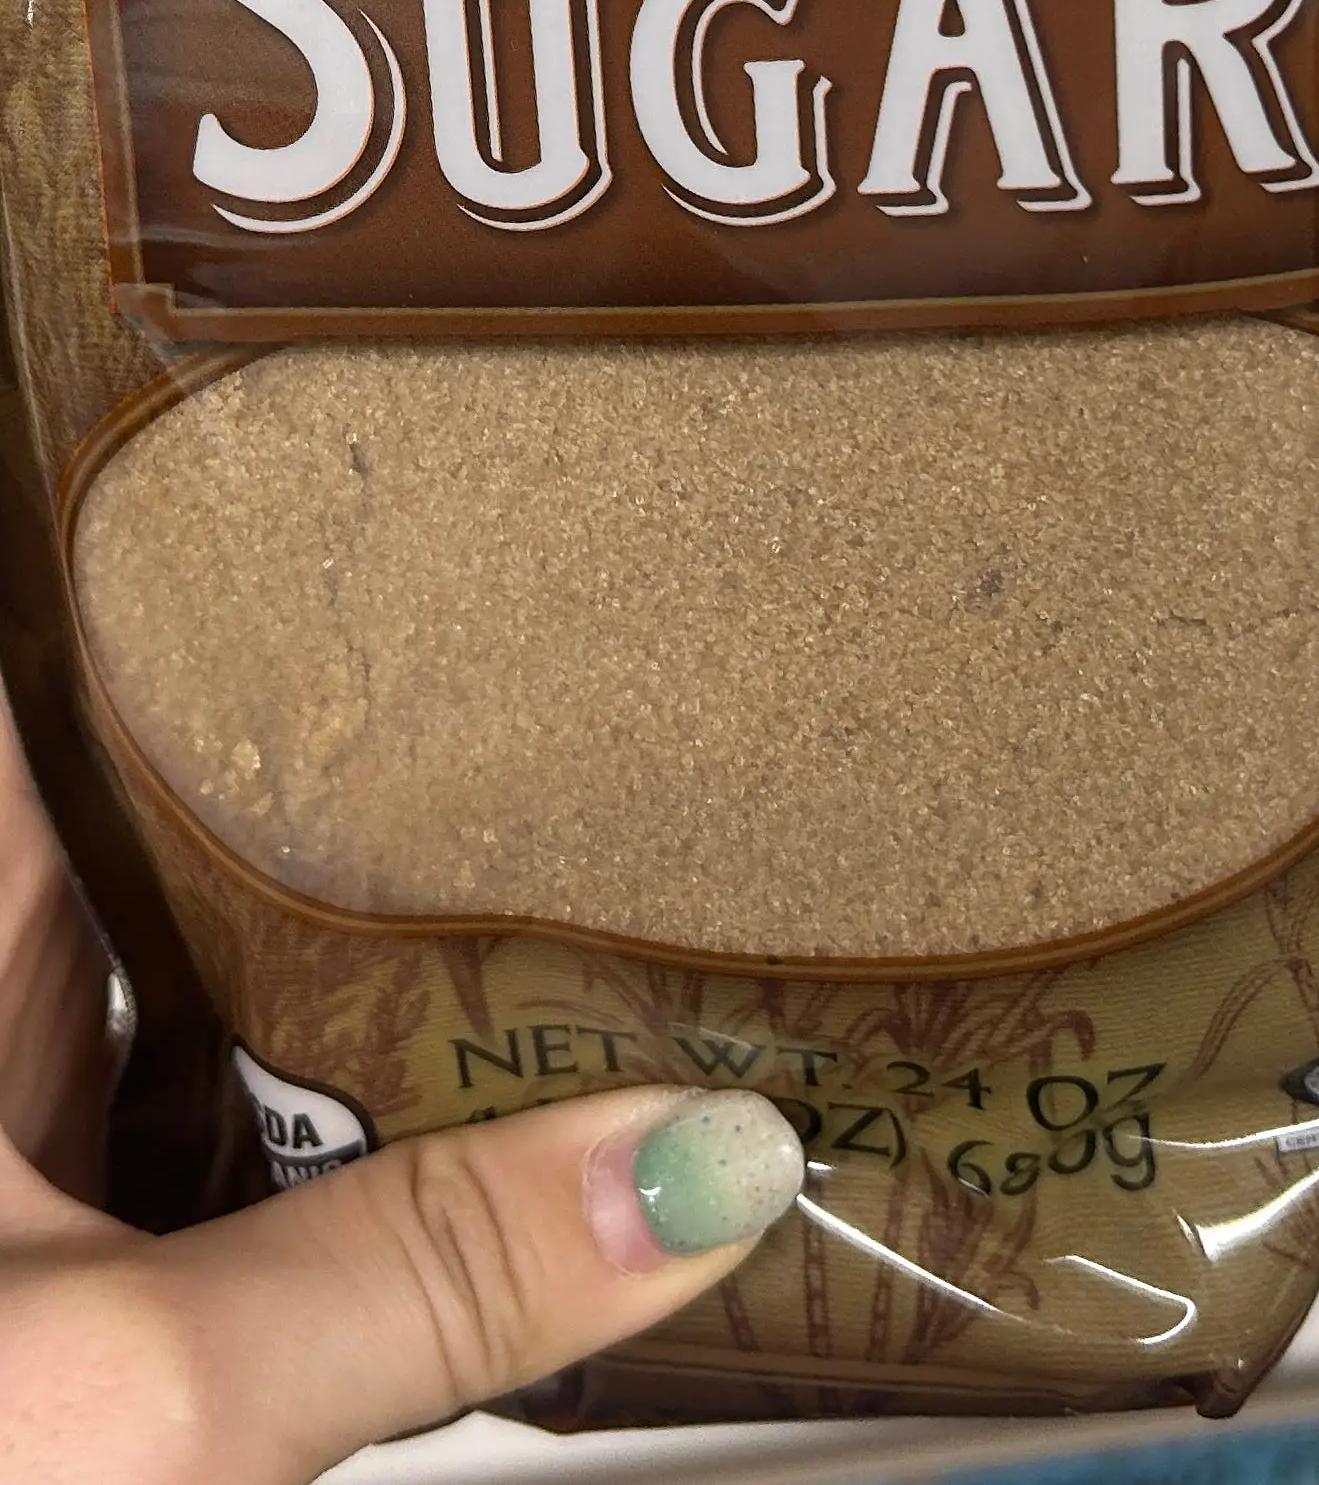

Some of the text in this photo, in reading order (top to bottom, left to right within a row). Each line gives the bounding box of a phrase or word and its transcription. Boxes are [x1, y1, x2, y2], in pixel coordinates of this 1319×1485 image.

[450, 1023, 637, 1089] NET
[669, 1033, 853, 1091] WT.
[886, 1060, 992, 1110] 24
[252, 1097, 323, 1150] DA
